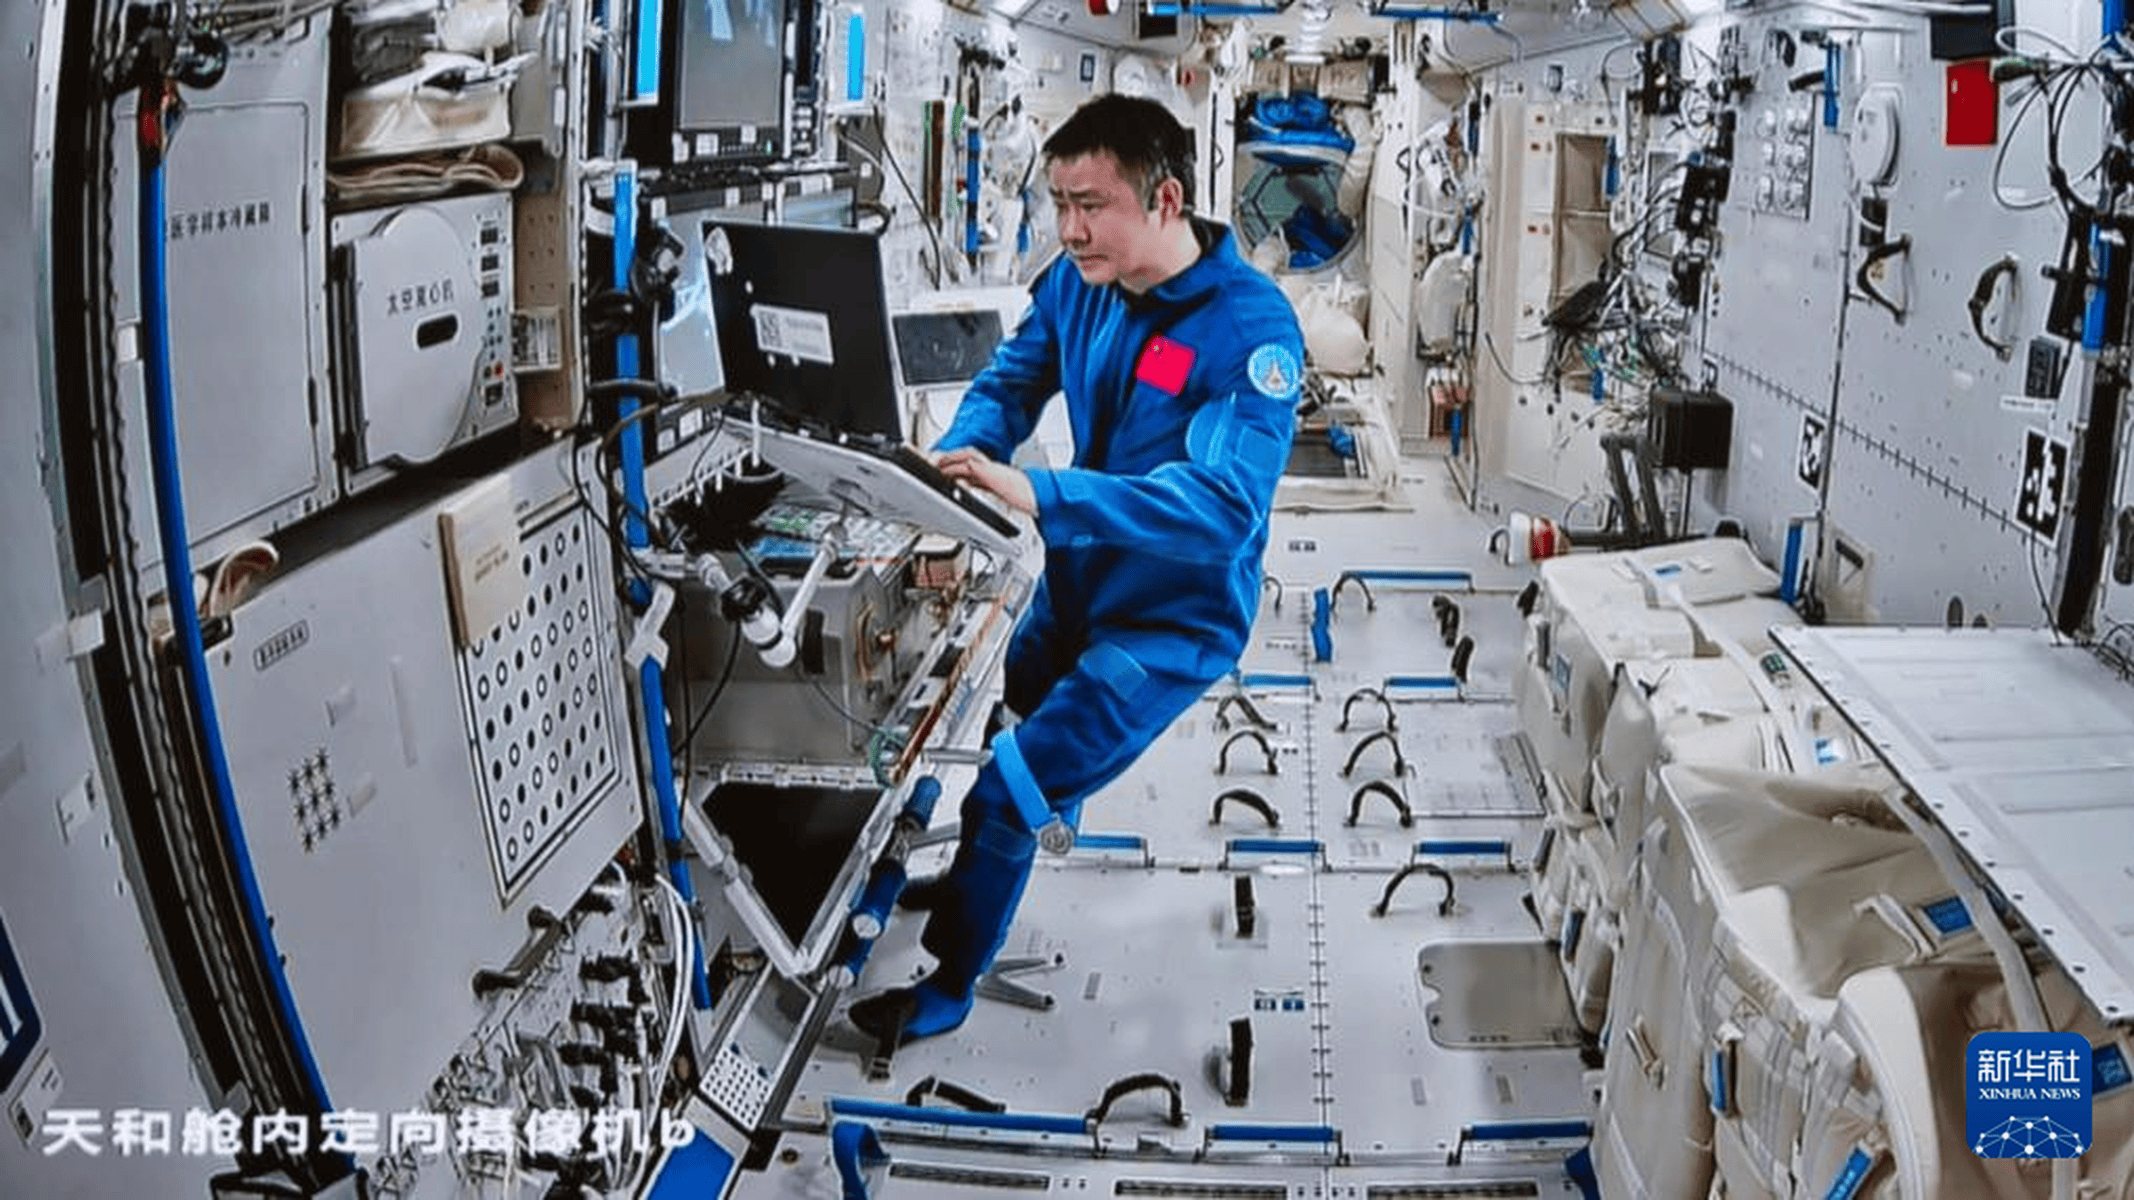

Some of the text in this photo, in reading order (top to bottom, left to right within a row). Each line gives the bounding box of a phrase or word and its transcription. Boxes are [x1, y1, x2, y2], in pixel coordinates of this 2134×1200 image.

[387, 278, 454, 317] 太空离心机
